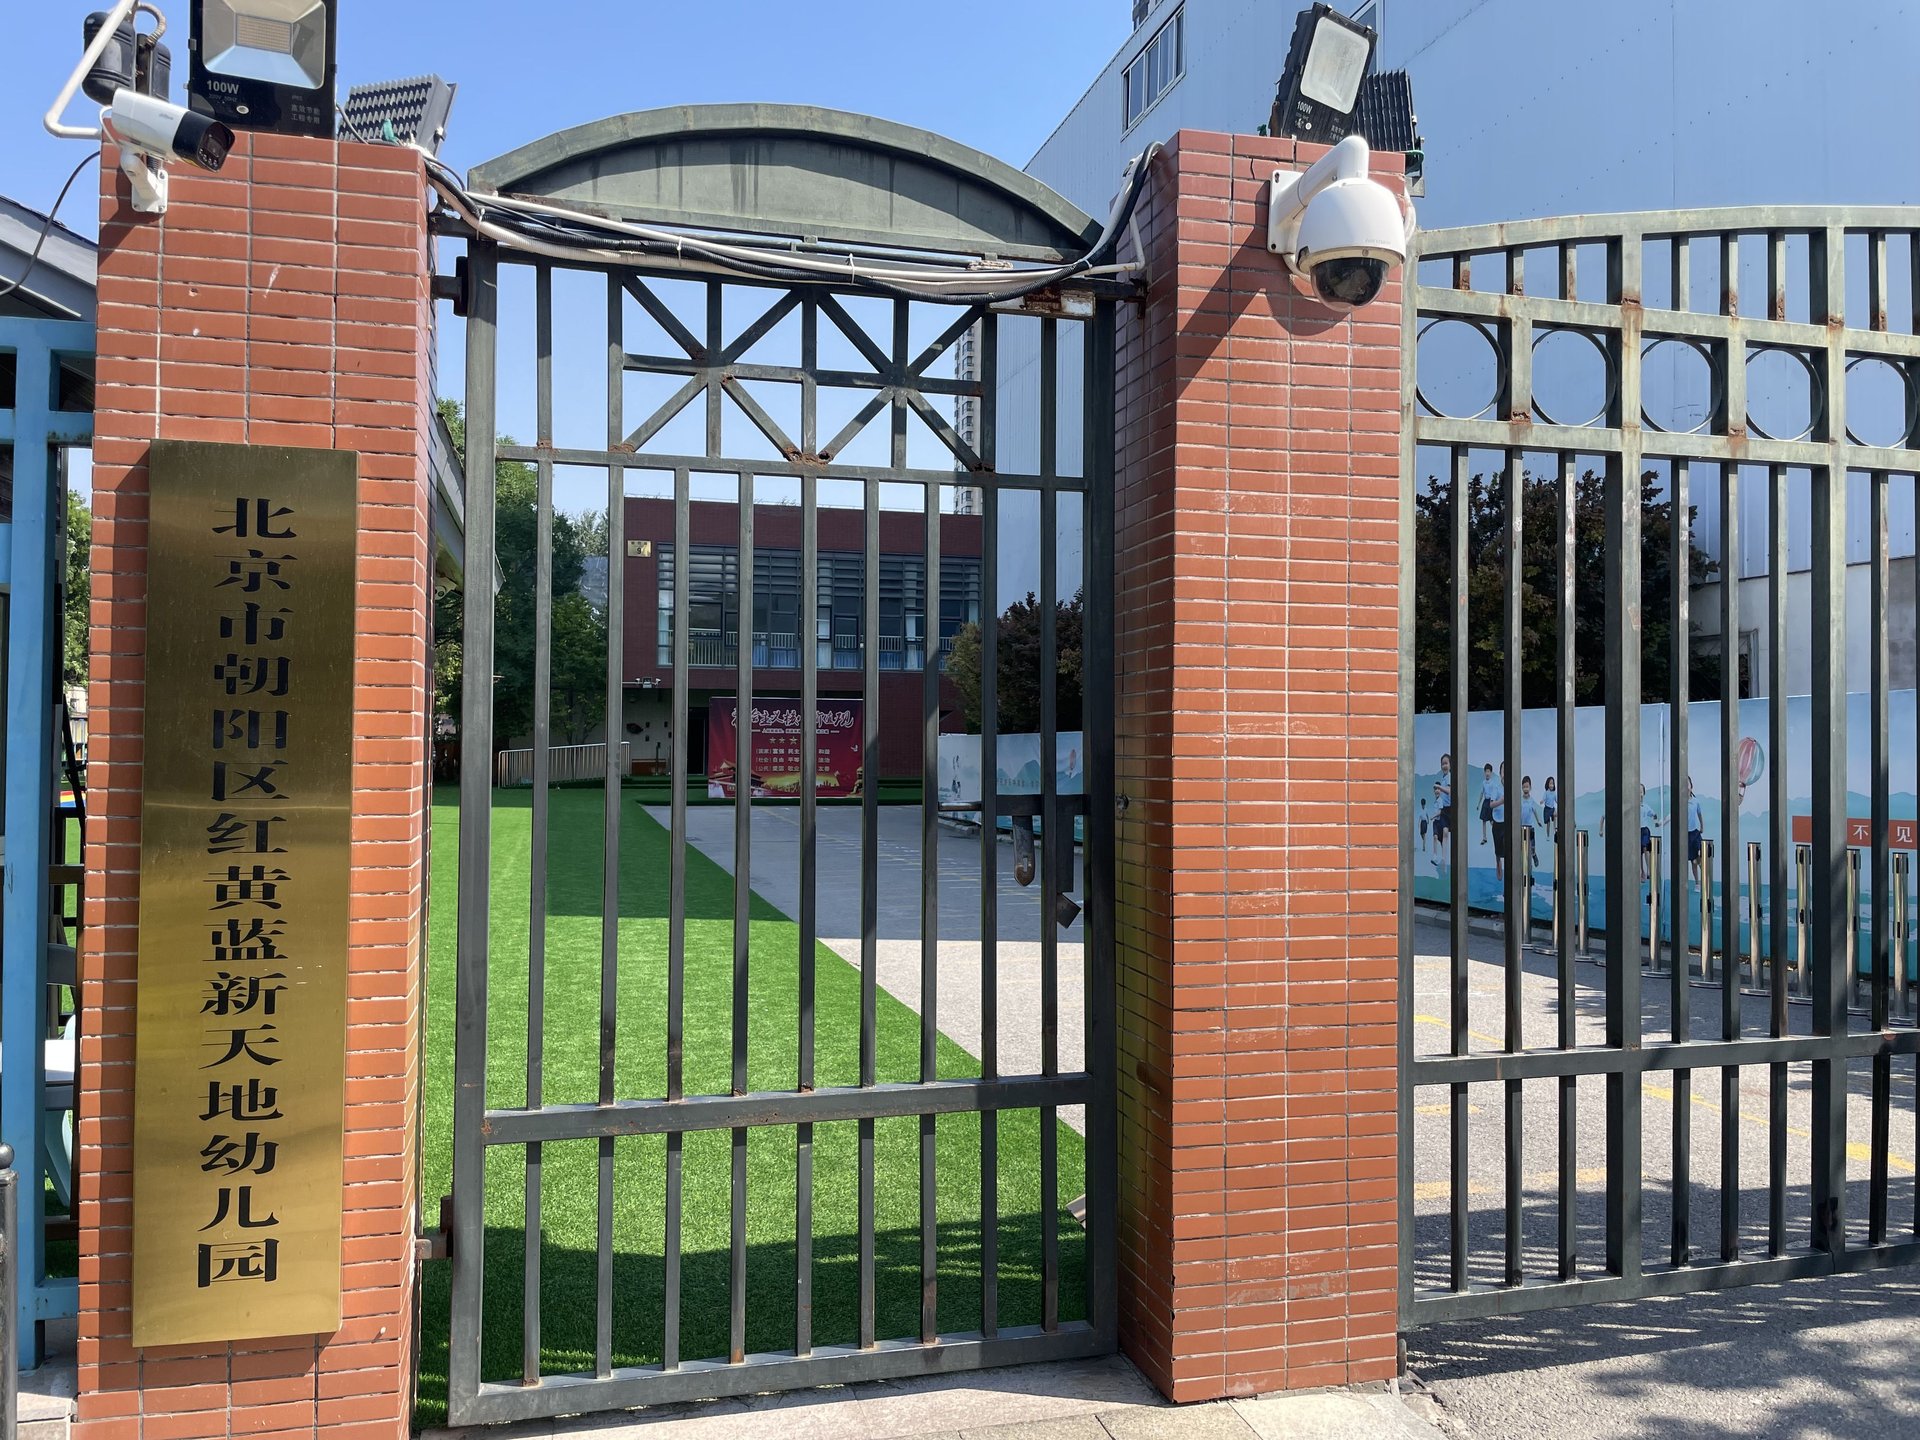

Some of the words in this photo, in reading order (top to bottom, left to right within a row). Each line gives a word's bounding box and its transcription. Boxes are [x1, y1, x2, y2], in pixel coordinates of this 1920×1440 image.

[207, 80, 239, 95] 100W
[1297, 101, 1313, 114] 100W
[197, 498, 298, 1288] 北京市朝阳区红黄蓝新天地幼儿园
